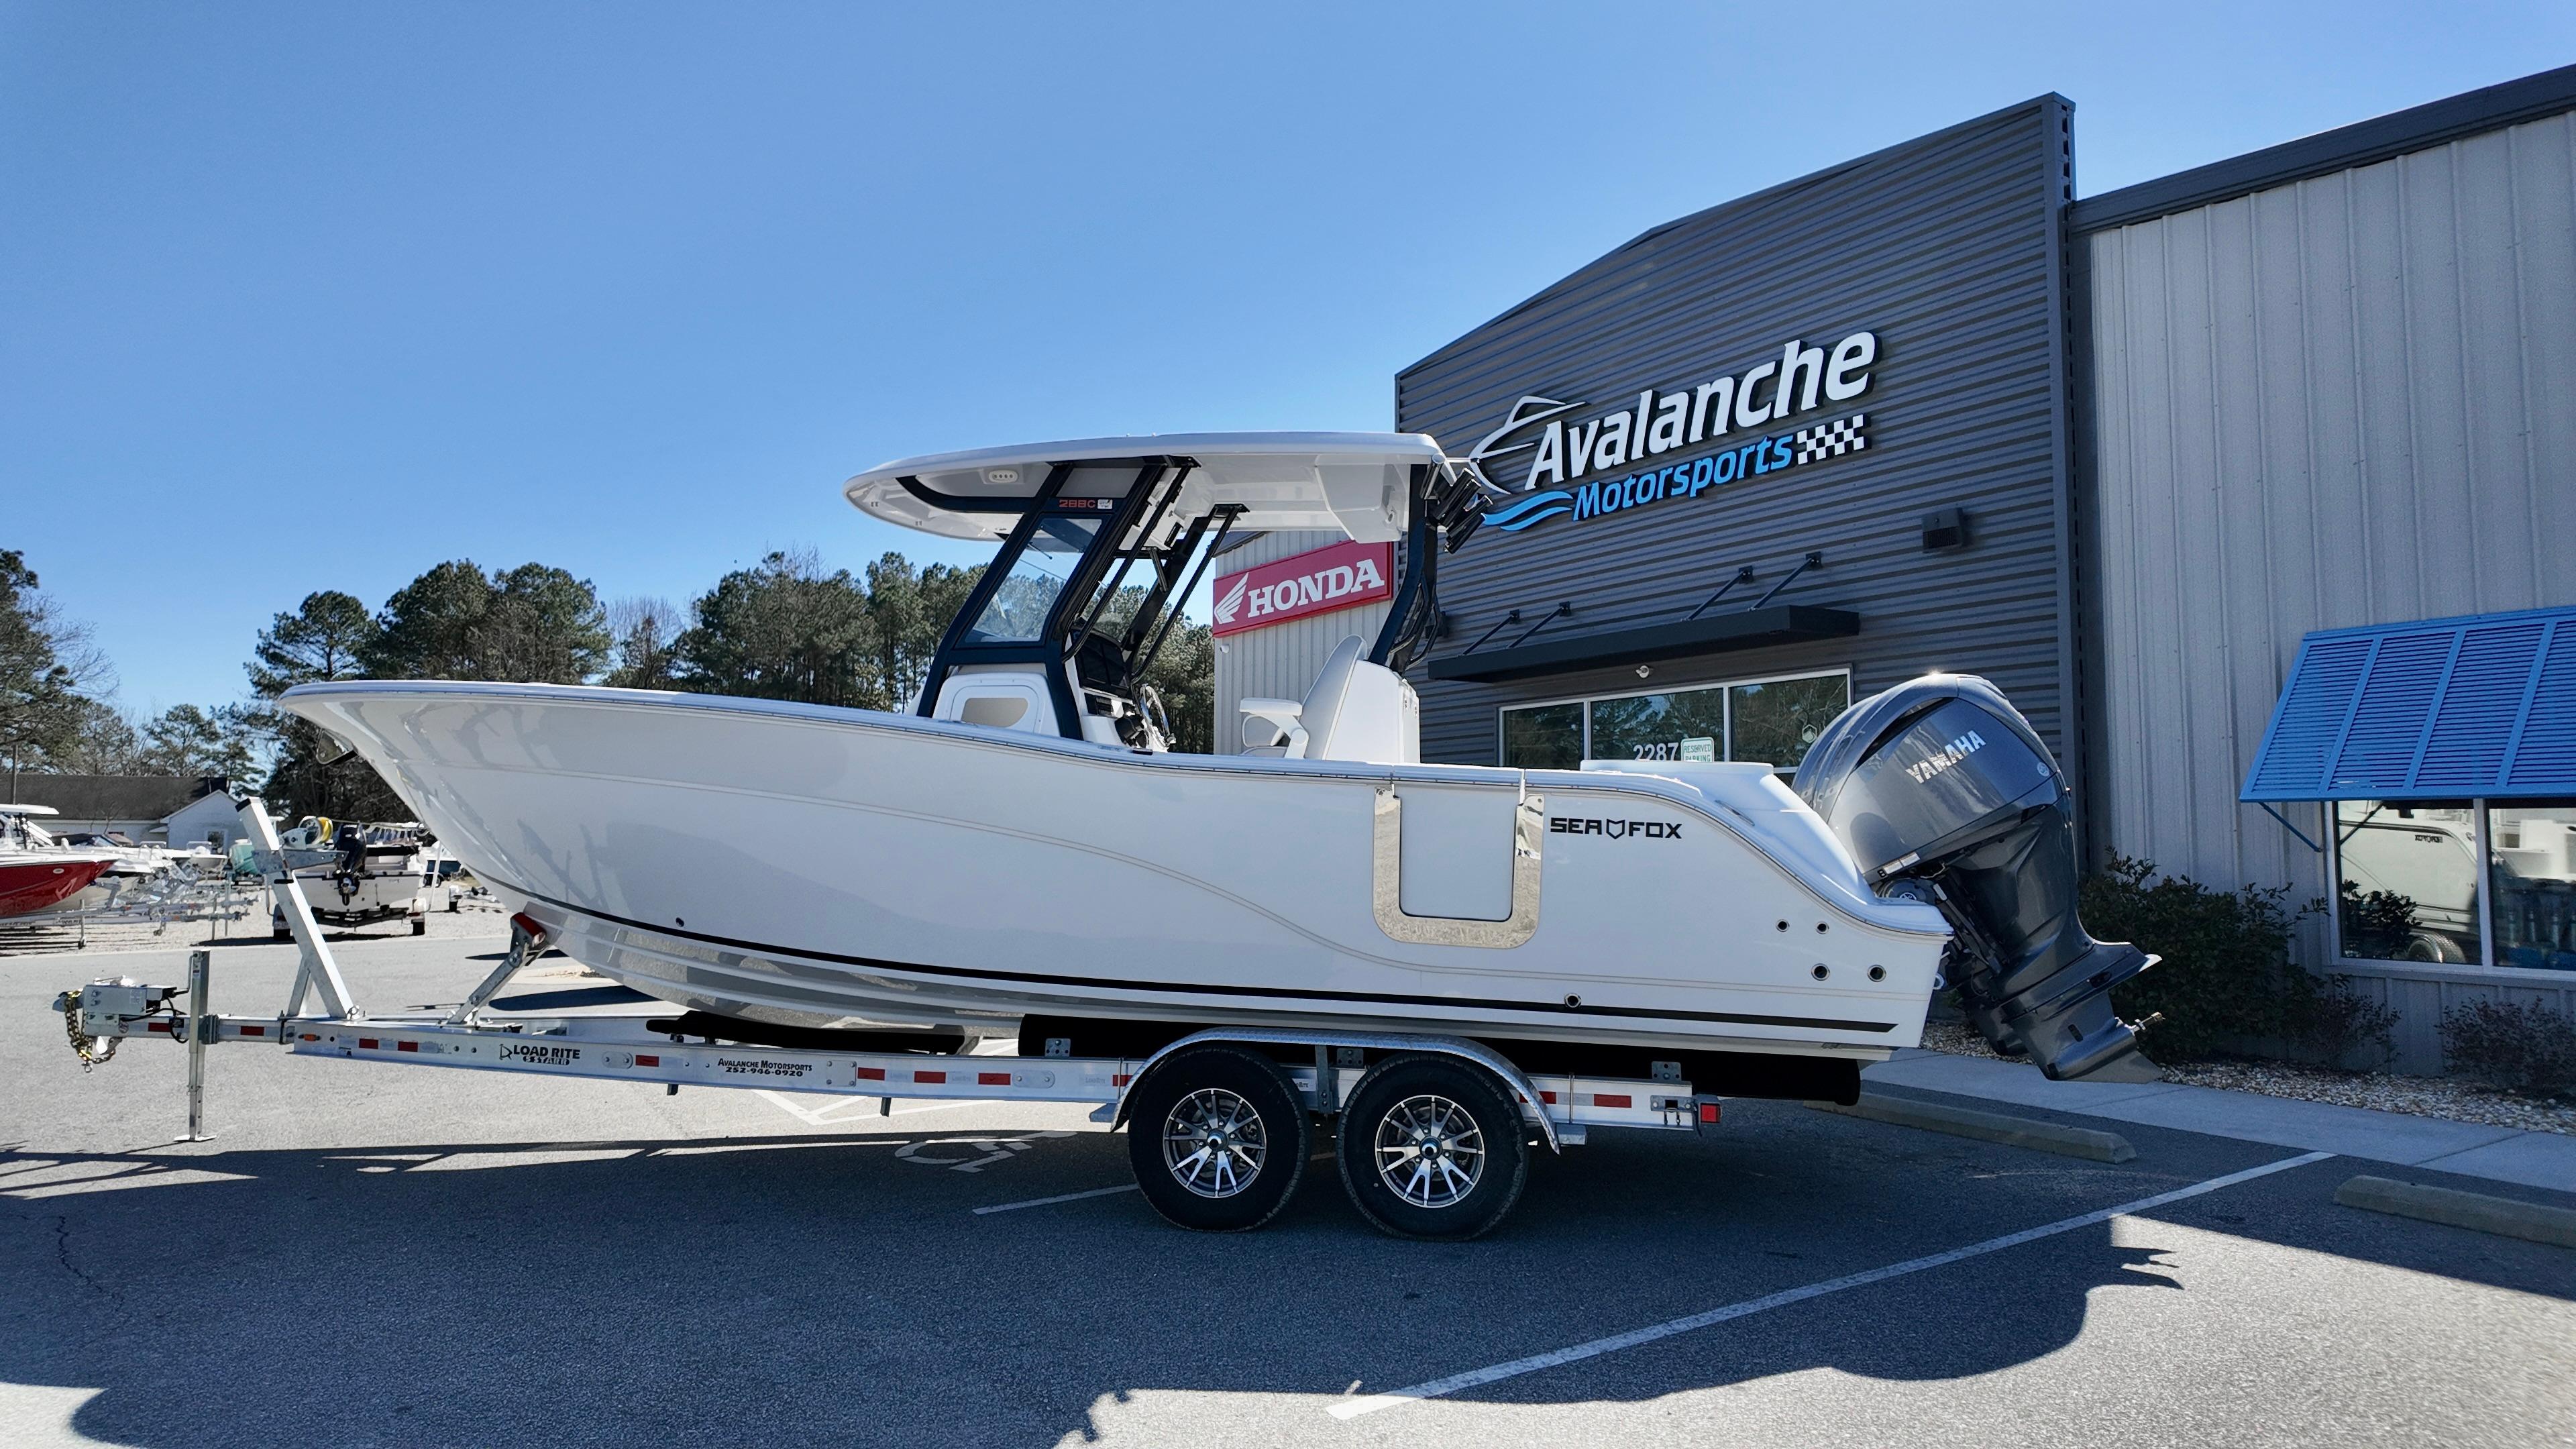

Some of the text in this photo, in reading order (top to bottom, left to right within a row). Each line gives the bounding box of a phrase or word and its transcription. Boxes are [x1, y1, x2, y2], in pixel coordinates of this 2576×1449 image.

[1524, 331, 1876, 491] Avalanche
[1572, 433, 1794, 521] Motorsports
[1248, 558, 1385, 619] HONDA
[1633, 742, 1679, 761] 2287
[1684, 744, 1712, 753] RESERVED
[1905, 730, 1986, 784] YAMAHA
[1550, 817, 1682, 839] SEA FOX
[513, 1044, 581, 1059] LOAD RITE
[725, 1067, 804, 1077] 252-946-0920
